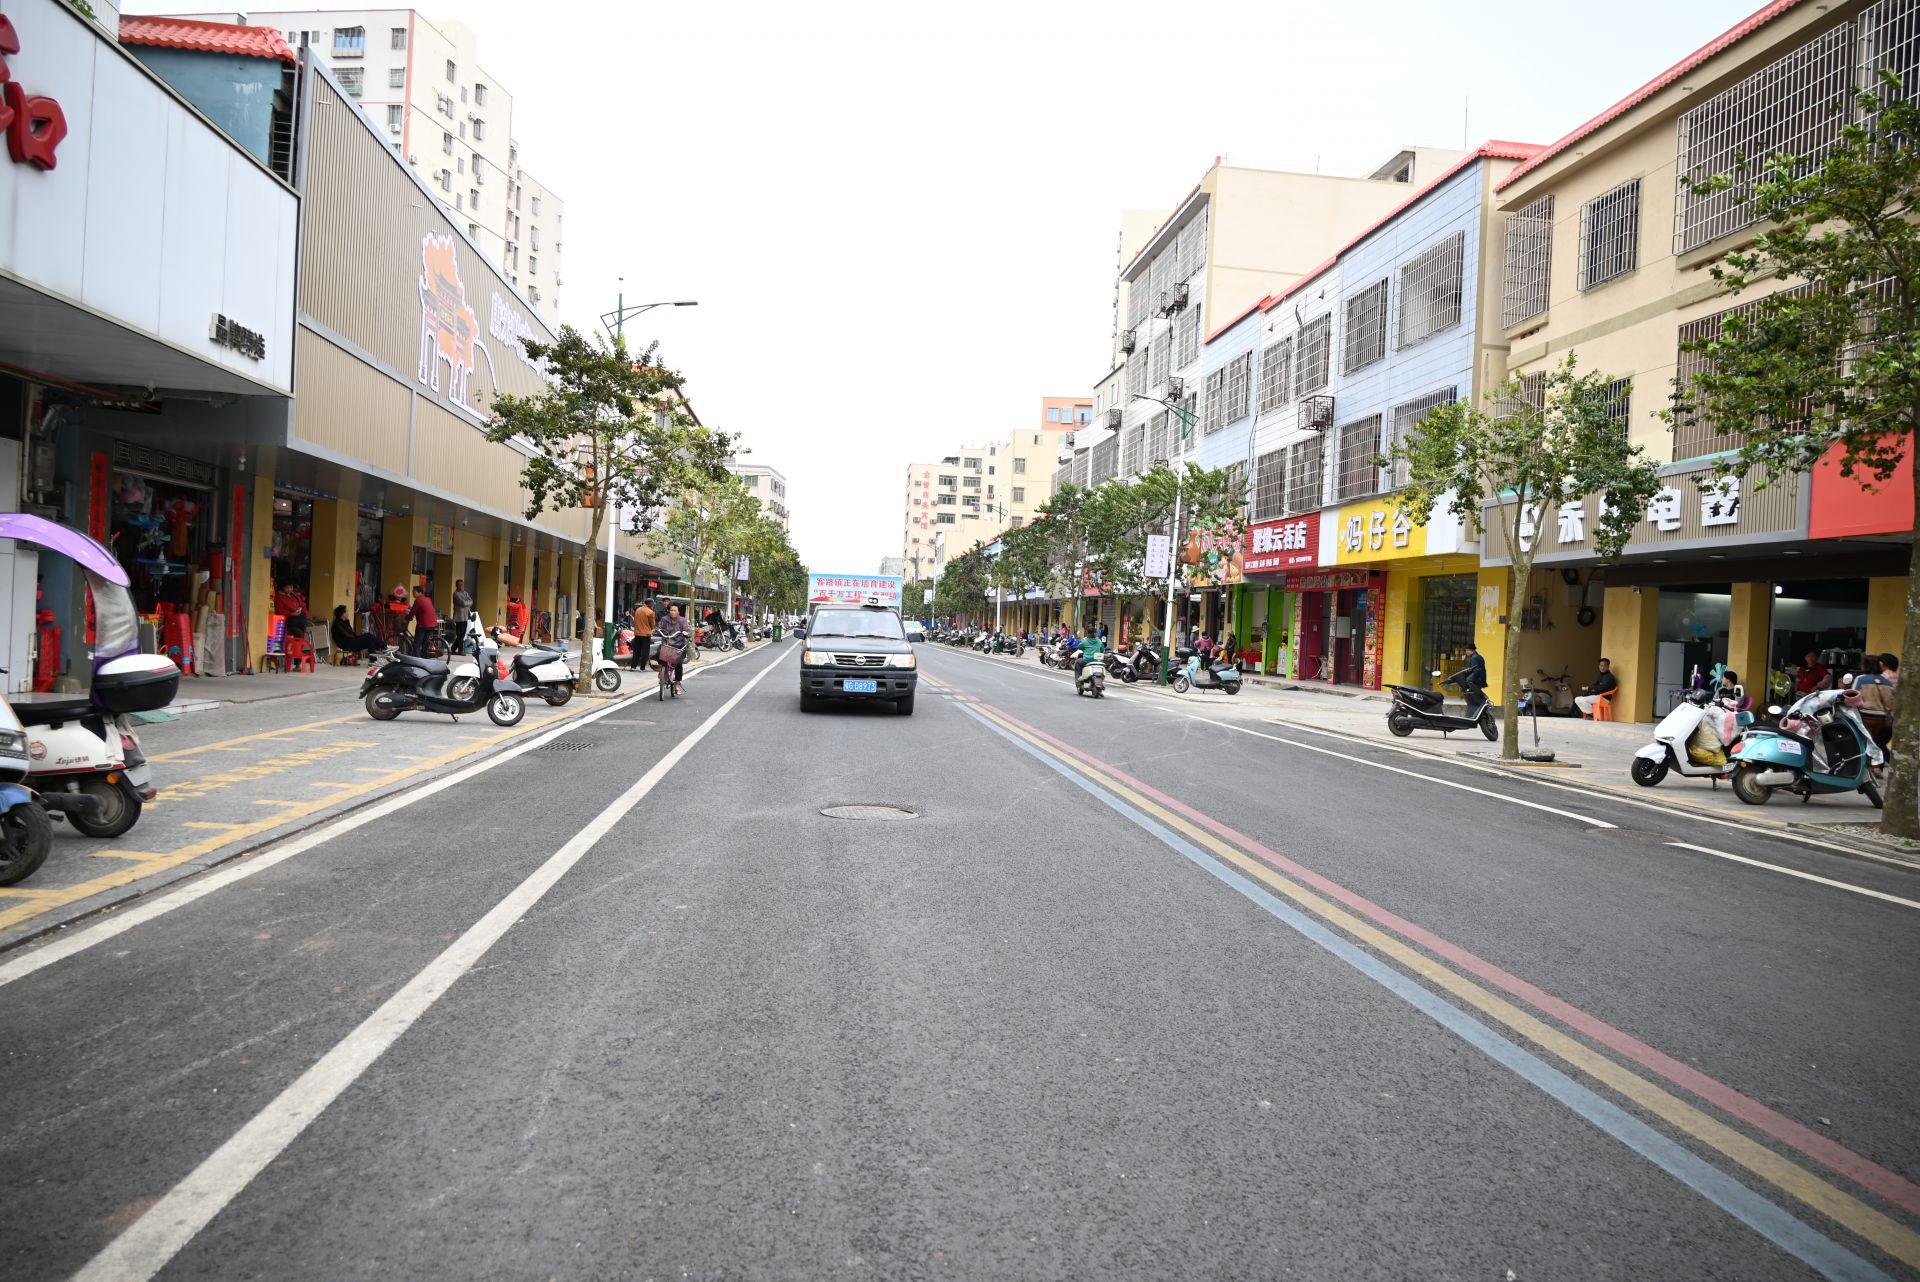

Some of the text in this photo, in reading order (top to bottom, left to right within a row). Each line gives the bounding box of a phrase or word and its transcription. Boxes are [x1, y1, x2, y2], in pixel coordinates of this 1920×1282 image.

[1346, 508, 1411, 552] 妈仔谷
[817, 578, 896, 588] 客路镇正在培育建设
